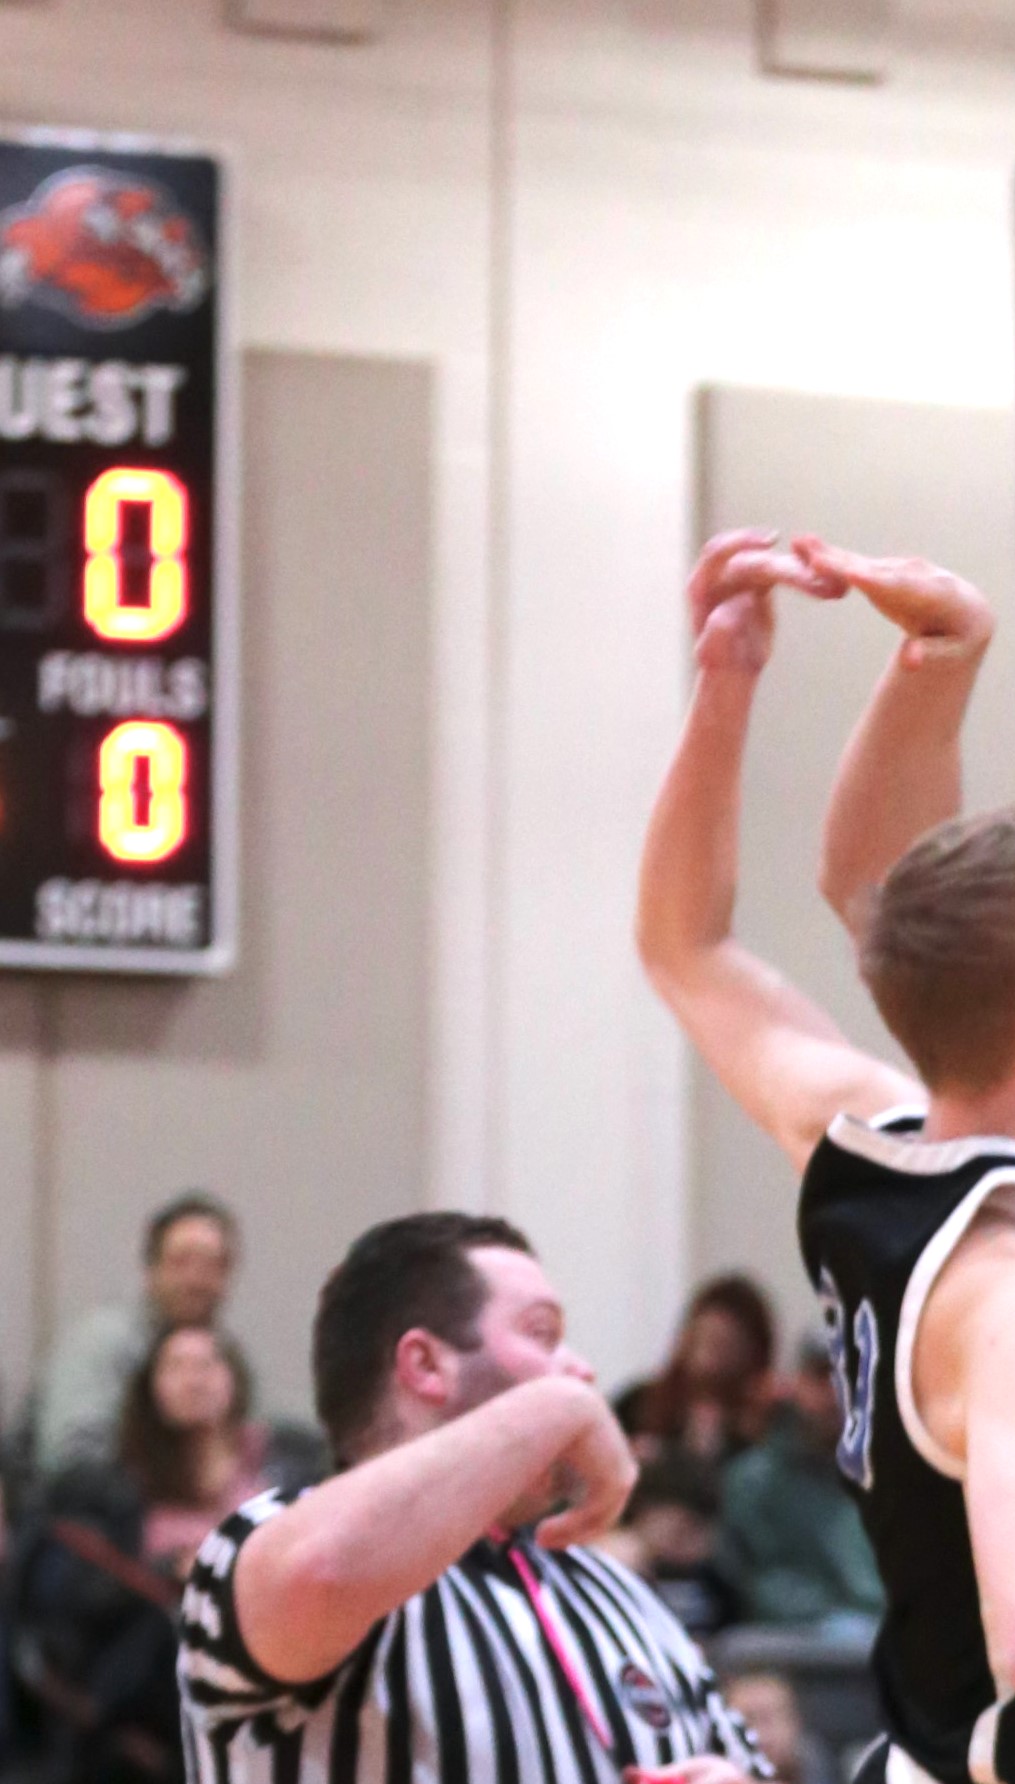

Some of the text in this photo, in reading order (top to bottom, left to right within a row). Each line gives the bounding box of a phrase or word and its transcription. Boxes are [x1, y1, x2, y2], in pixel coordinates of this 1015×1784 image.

[0, 354, 187, 446] UEST
[83, 465, 190, 642] 0
[37, 650, 208, 720] FOULS
[98, 720, 189, 864] 0
[35, 876, 203, 945] SCORE
